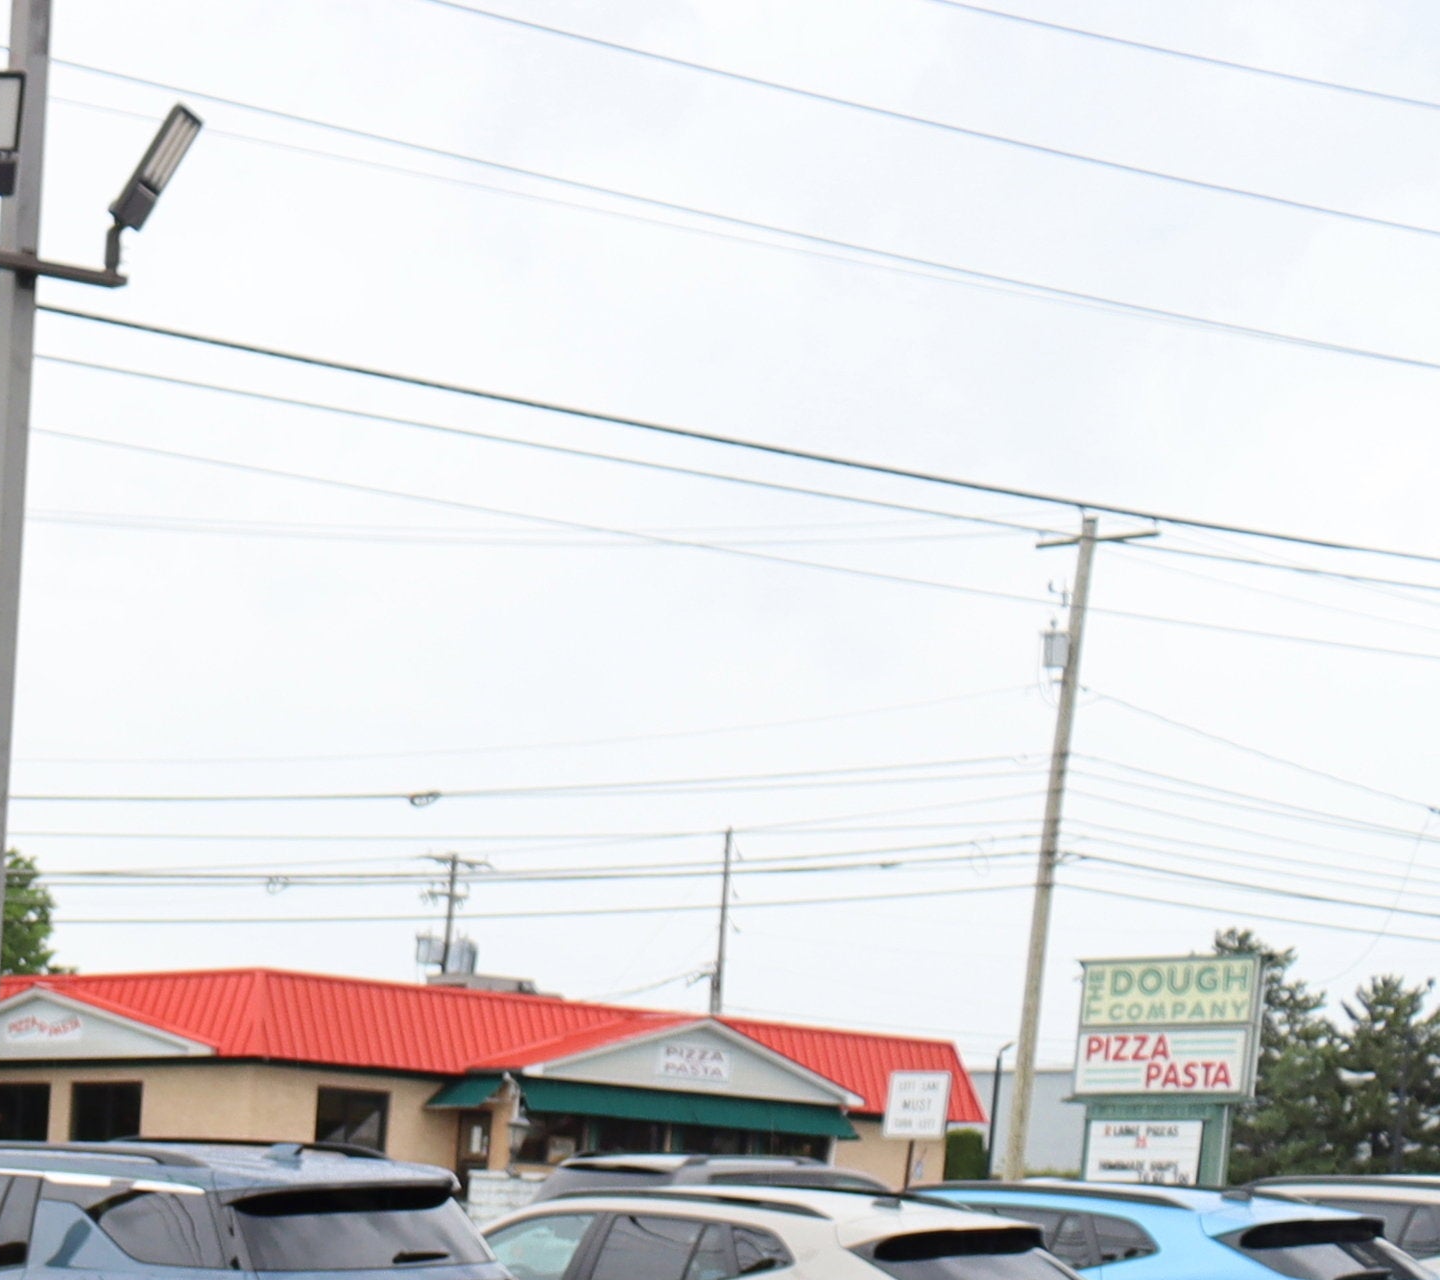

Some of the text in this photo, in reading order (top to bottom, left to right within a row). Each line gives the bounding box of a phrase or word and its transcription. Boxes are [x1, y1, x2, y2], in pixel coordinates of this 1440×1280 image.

[1085, 969, 1106, 1021] THE
[1110, 965, 1248, 997] DOUGH
[1108, 1001, 1247, 1021] COMPANY
[665, 1046, 723, 1062] PIZZA
[1086, 1033, 1170, 1061] PIZZA
[1145, 1061, 1232, 1089] PASTA
